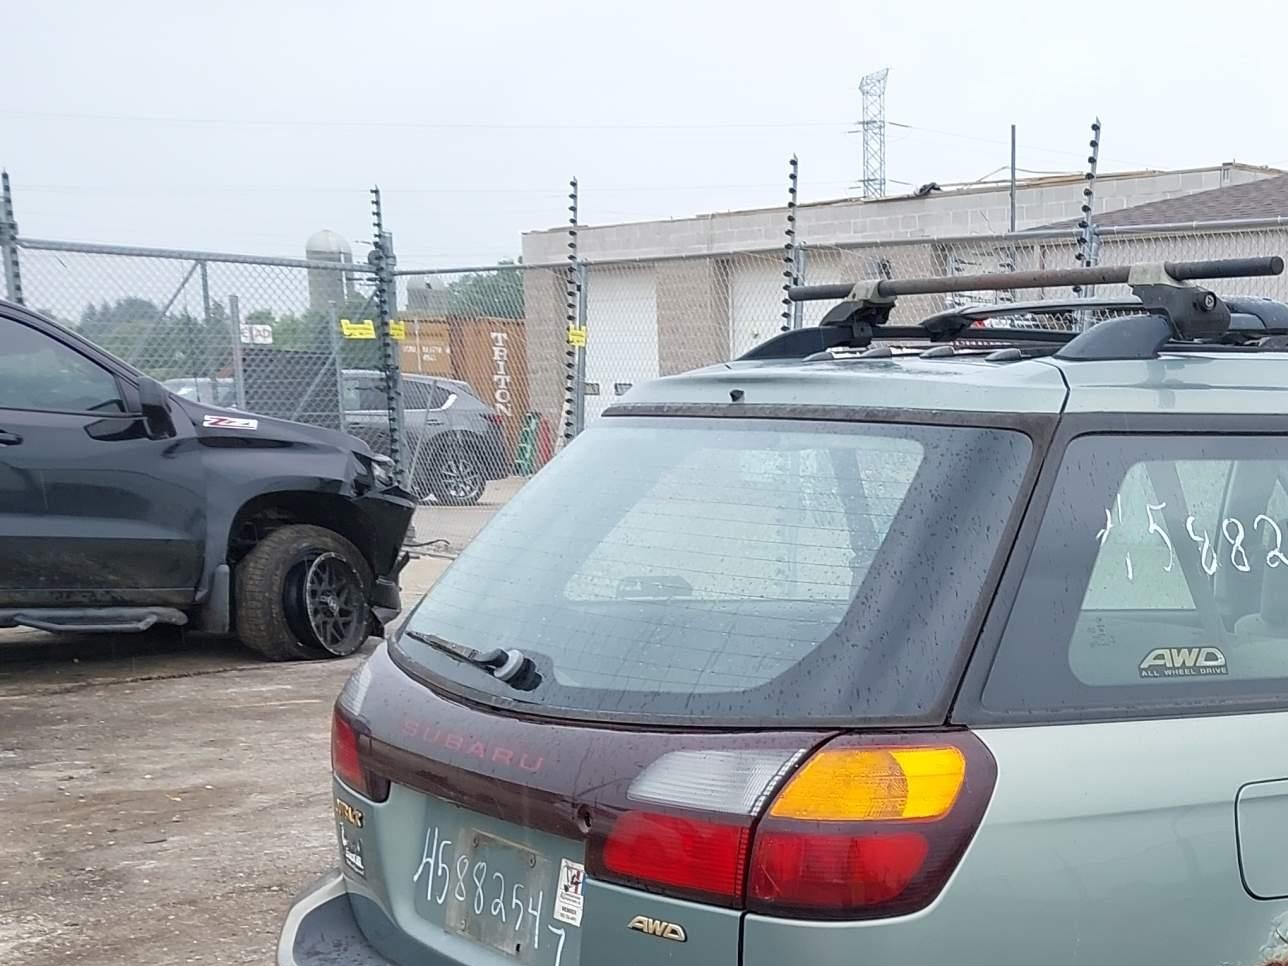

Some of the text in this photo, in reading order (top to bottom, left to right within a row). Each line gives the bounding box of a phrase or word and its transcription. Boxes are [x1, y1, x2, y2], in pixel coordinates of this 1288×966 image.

[490, 332, 513, 417] TRITON
[1140, 648, 1226, 668] AWD
[1141, 669, 1160, 677] ALL
[1164, 668, 1195, 676] WHEEL
[401, 719, 545, 770] SUBARU
[627, 915, 686, 941] AWD
